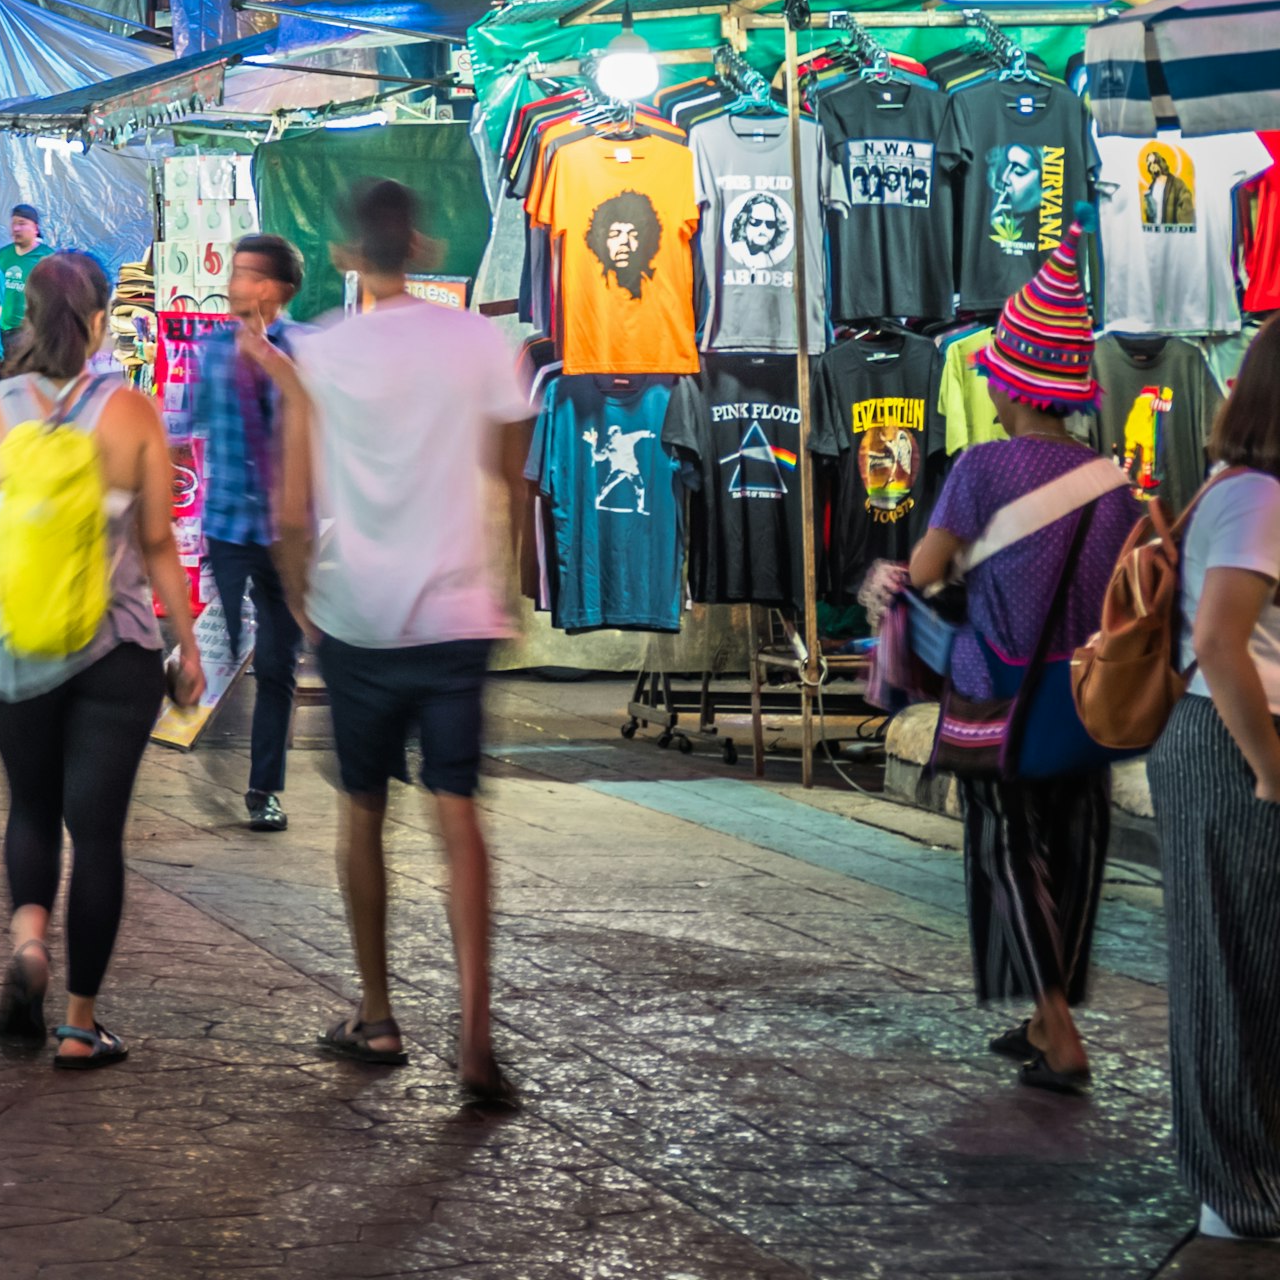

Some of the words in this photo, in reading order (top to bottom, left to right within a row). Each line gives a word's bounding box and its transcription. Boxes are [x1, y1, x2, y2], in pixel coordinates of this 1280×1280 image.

[864, 142, 915, 157] N.W.A
[754, 175, 793, 191] DUD
[1038, 145, 1066, 252] NIRVANA
[711, 402, 749, 422] PINK
[751, 403, 801, 424] FLOYD
